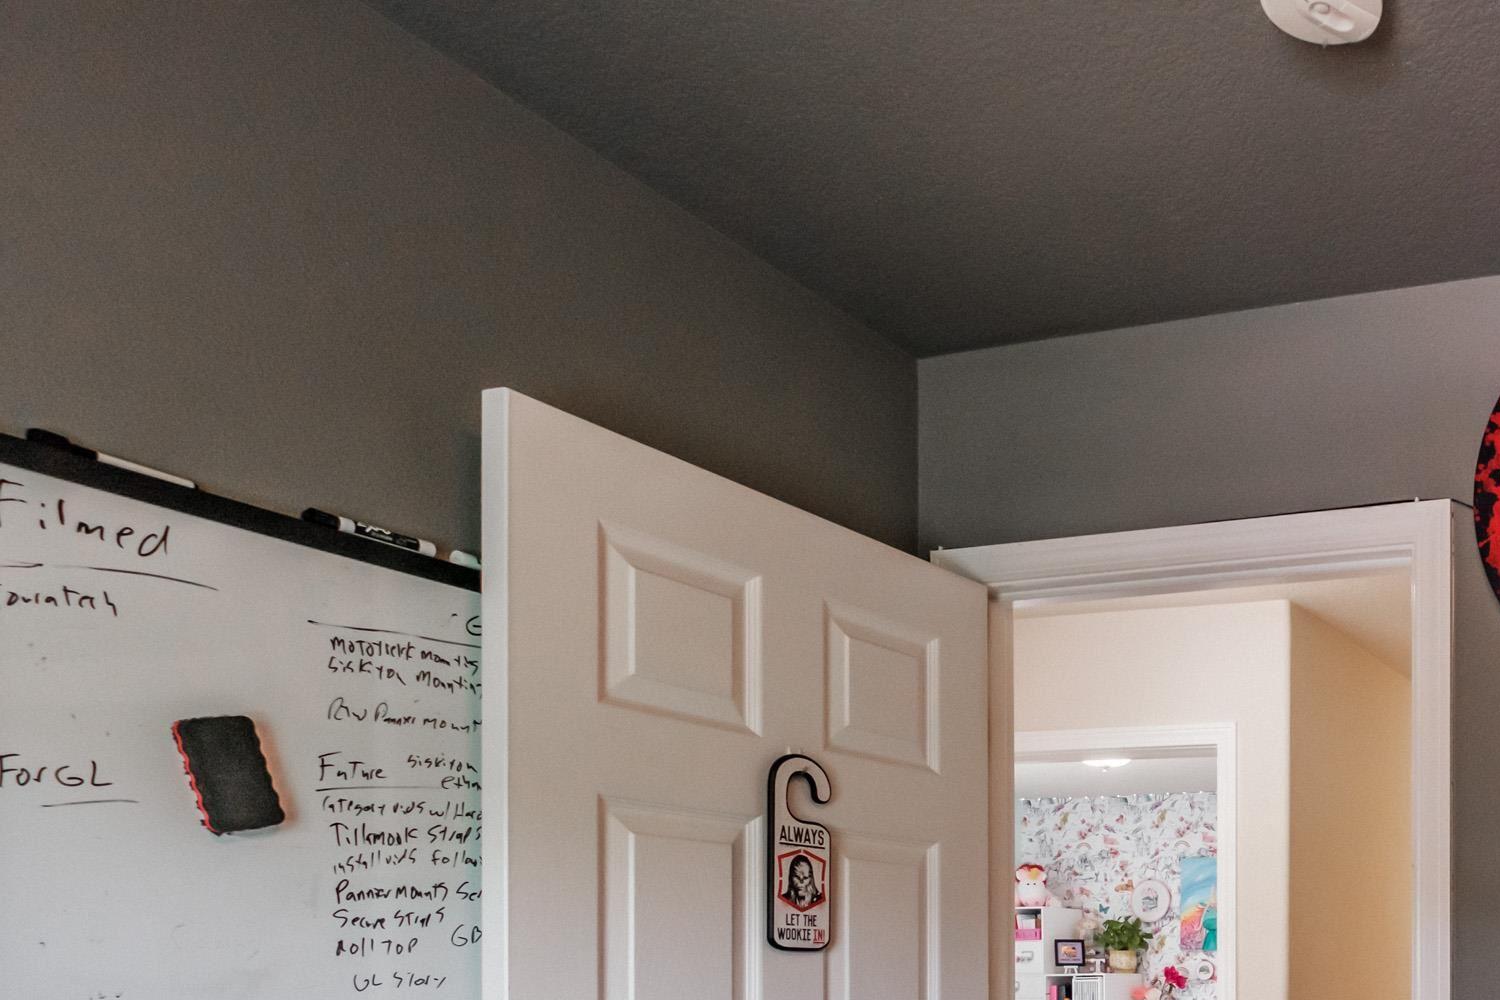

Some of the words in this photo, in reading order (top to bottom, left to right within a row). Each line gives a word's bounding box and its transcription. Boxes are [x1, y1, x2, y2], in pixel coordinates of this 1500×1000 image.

[779, 824, 825, 846] ALWAYS
[785, 913, 800, 927] LET
[803, 913, 817, 928] THE
[777, 927, 812, 942] WOOKIE
[813, 928, 826, 942] IN!
